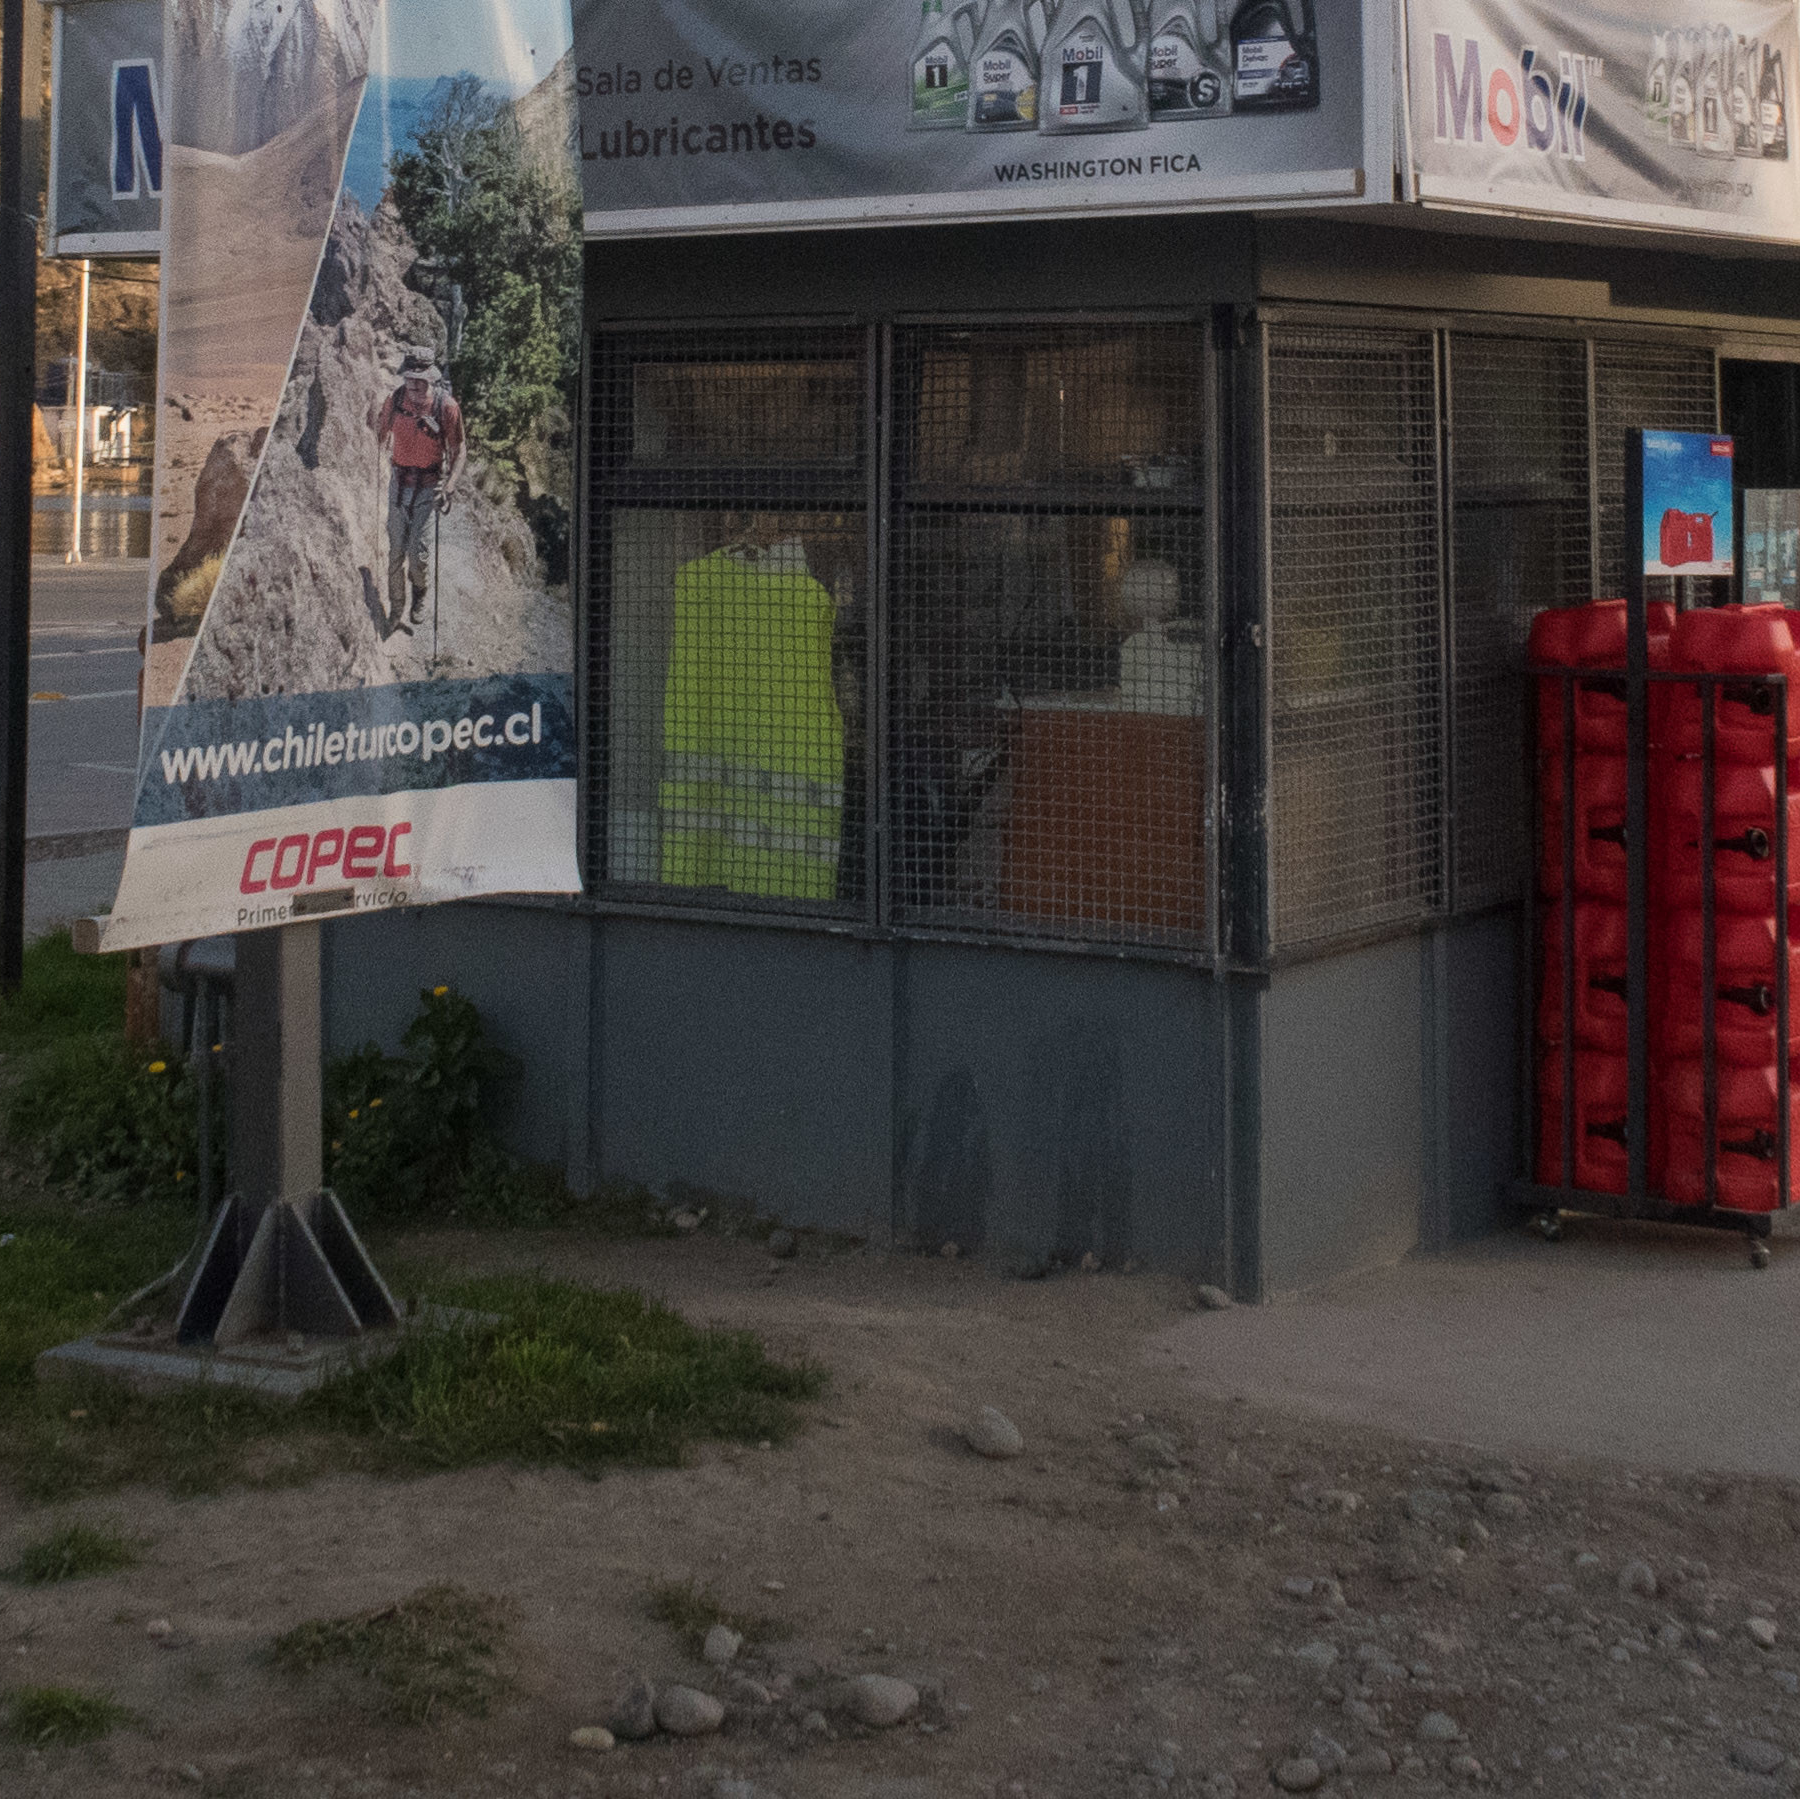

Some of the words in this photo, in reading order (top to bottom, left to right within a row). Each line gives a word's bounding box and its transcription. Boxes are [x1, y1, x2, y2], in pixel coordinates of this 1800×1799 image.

[983, 59, 1011, 71] Mobil
[1062, 46, 1103, 61] Mobil
[576, 63, 642, 97] Sala
[654, 59, 694, 92] de
[704, 54, 822, 88] Ventas
[1073, 65, 1089, 101] 1
[1434, 33, 1587, 162] Mobil
[579, 113, 817, 161] Lubricantes
[994, 158, 1142, 182] WASHINGTON
[1150, 154, 1201, 174] FICA
[160, 702, 542, 785] www.chileturcopec.cl
[237, 904, 293, 927] Prime
